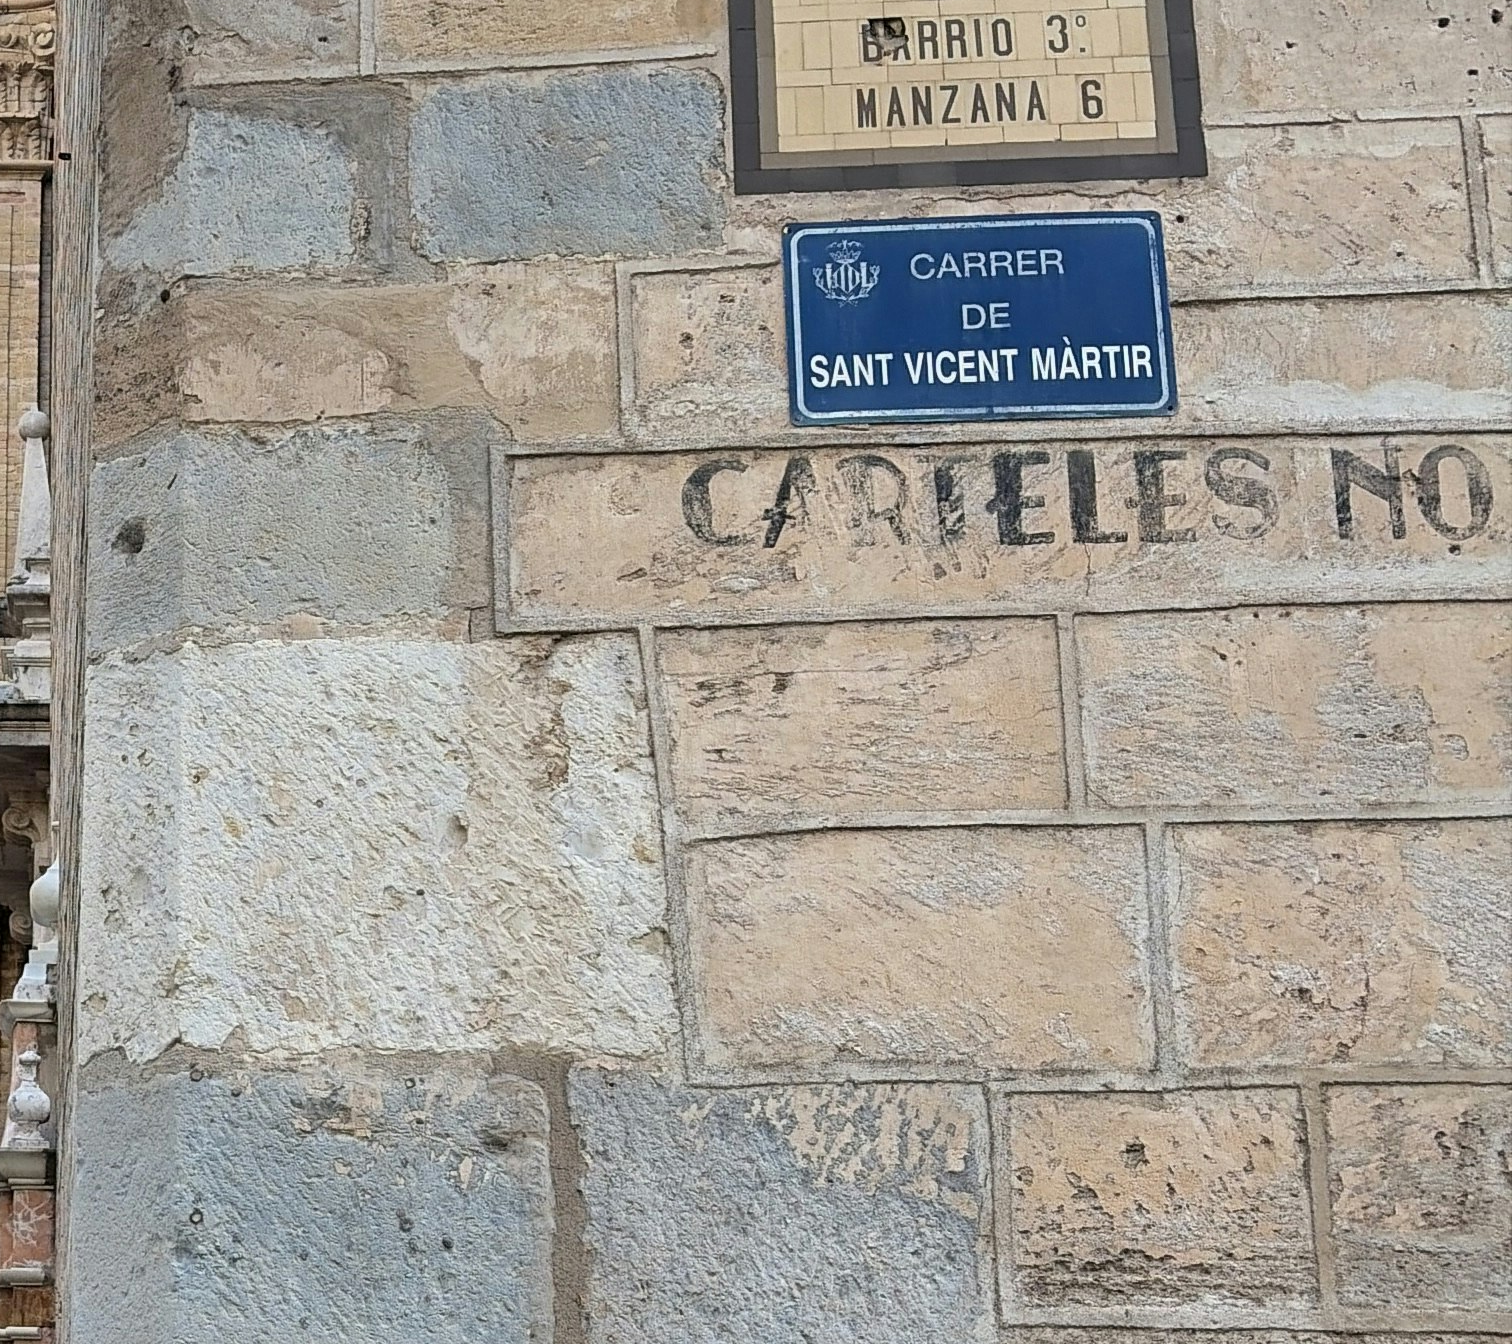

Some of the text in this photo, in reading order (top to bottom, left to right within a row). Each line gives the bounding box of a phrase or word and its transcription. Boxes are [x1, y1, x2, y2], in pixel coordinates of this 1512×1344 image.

[856, 79, 1104, 129] MANZANA 6
[909, 249, 1065, 281] CARRER
[962, 303, 1011, 330] DE
[809, 338, 1154, 389] SANT VICENT MÀRTIR
[1329, 440, 1494, 542] NO
